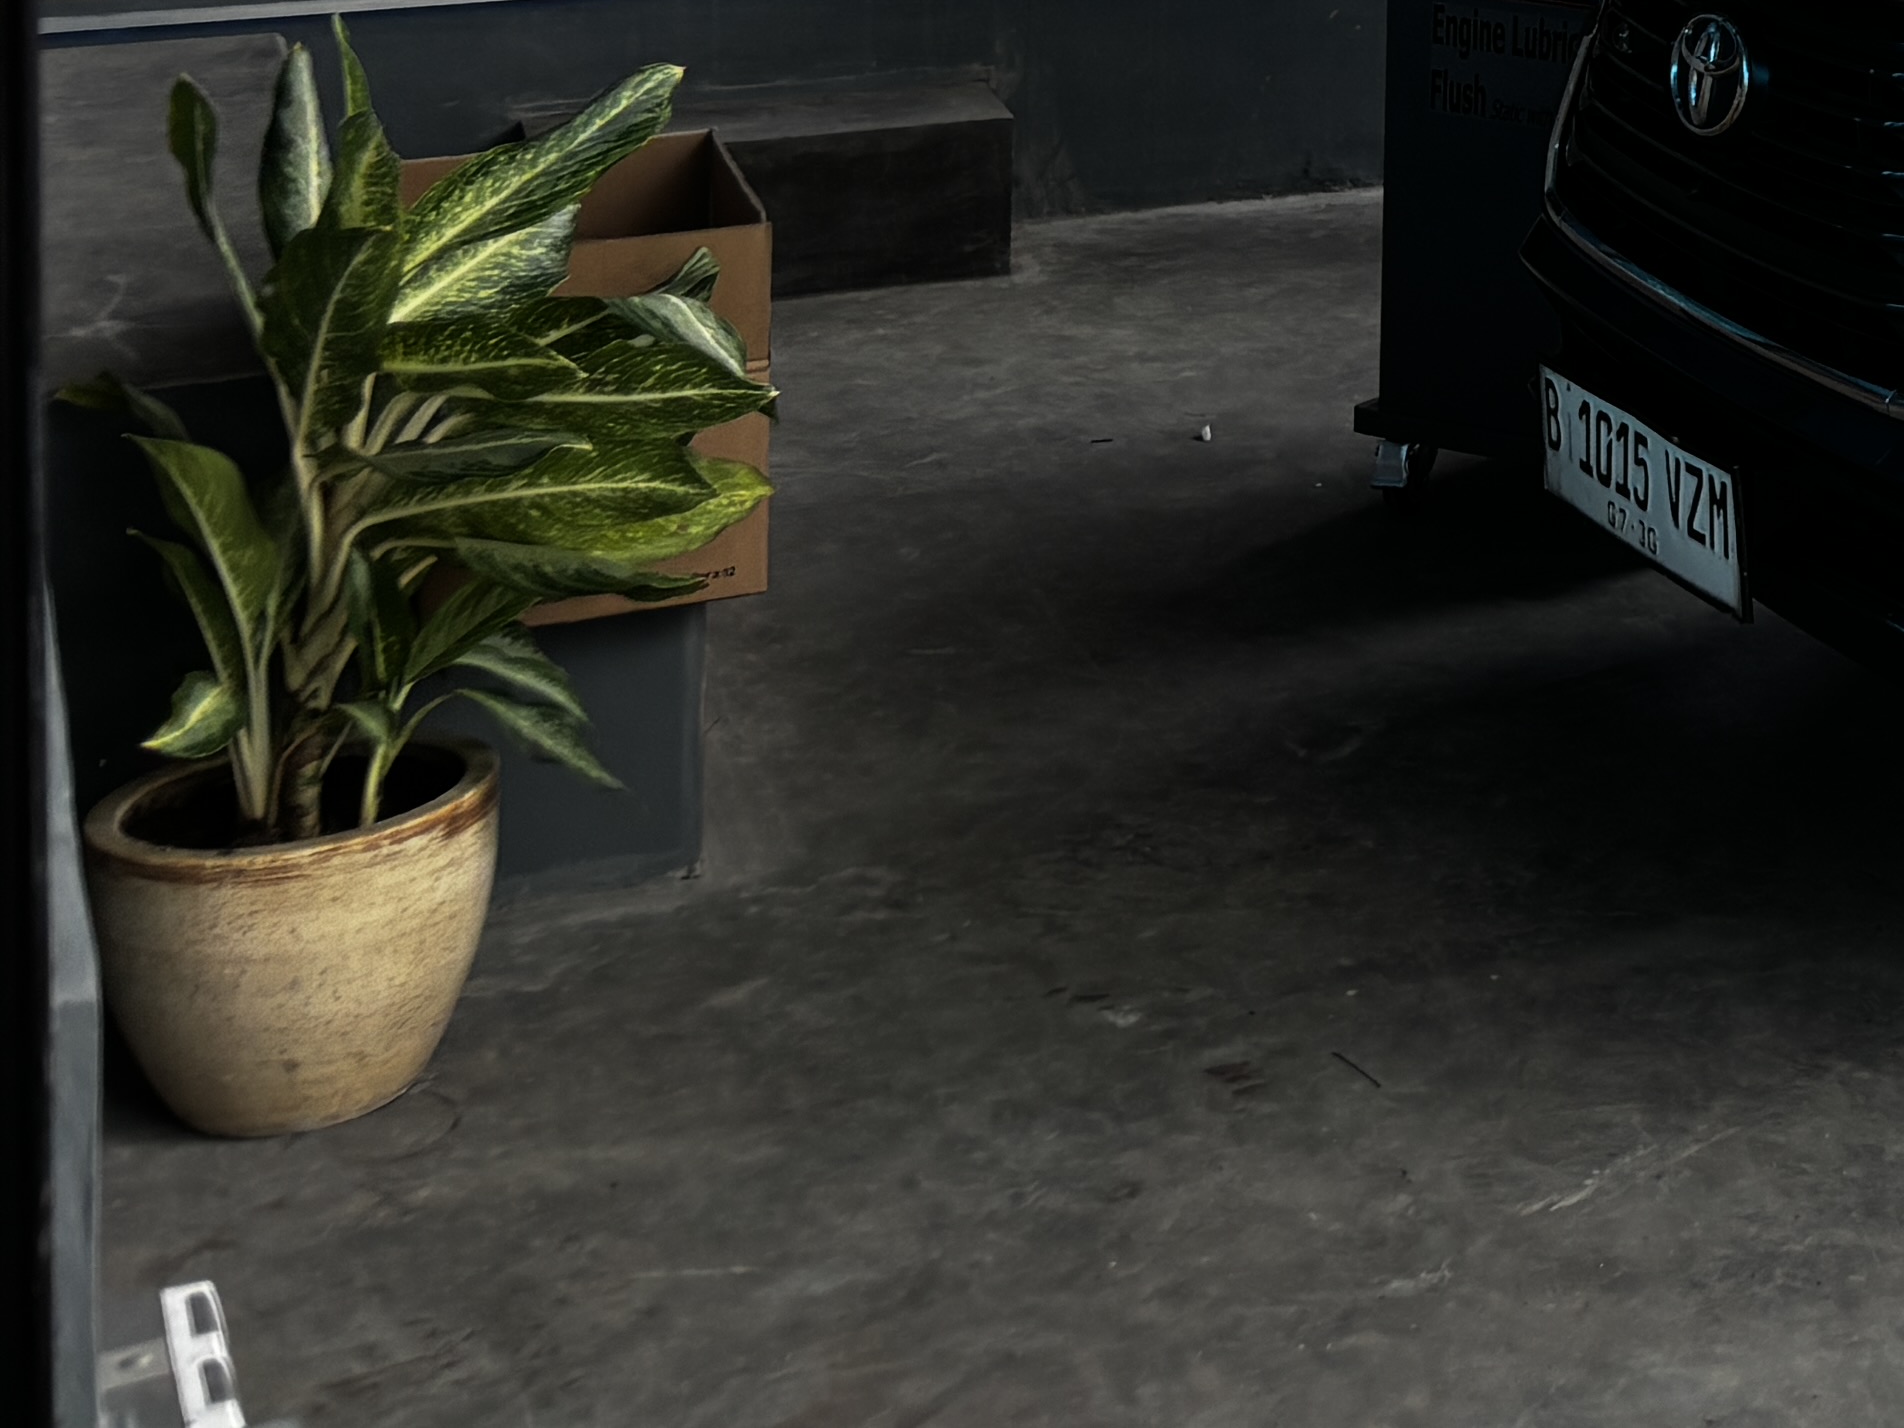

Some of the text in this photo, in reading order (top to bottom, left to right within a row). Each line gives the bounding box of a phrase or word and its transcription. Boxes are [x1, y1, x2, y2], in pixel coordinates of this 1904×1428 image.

[1433, 5, 1505, 60] Engine
[1430, 69, 1487, 118] Flush
[1545, 376, 1562, 451] B
[1664, 448, 1730, 560] VZM
